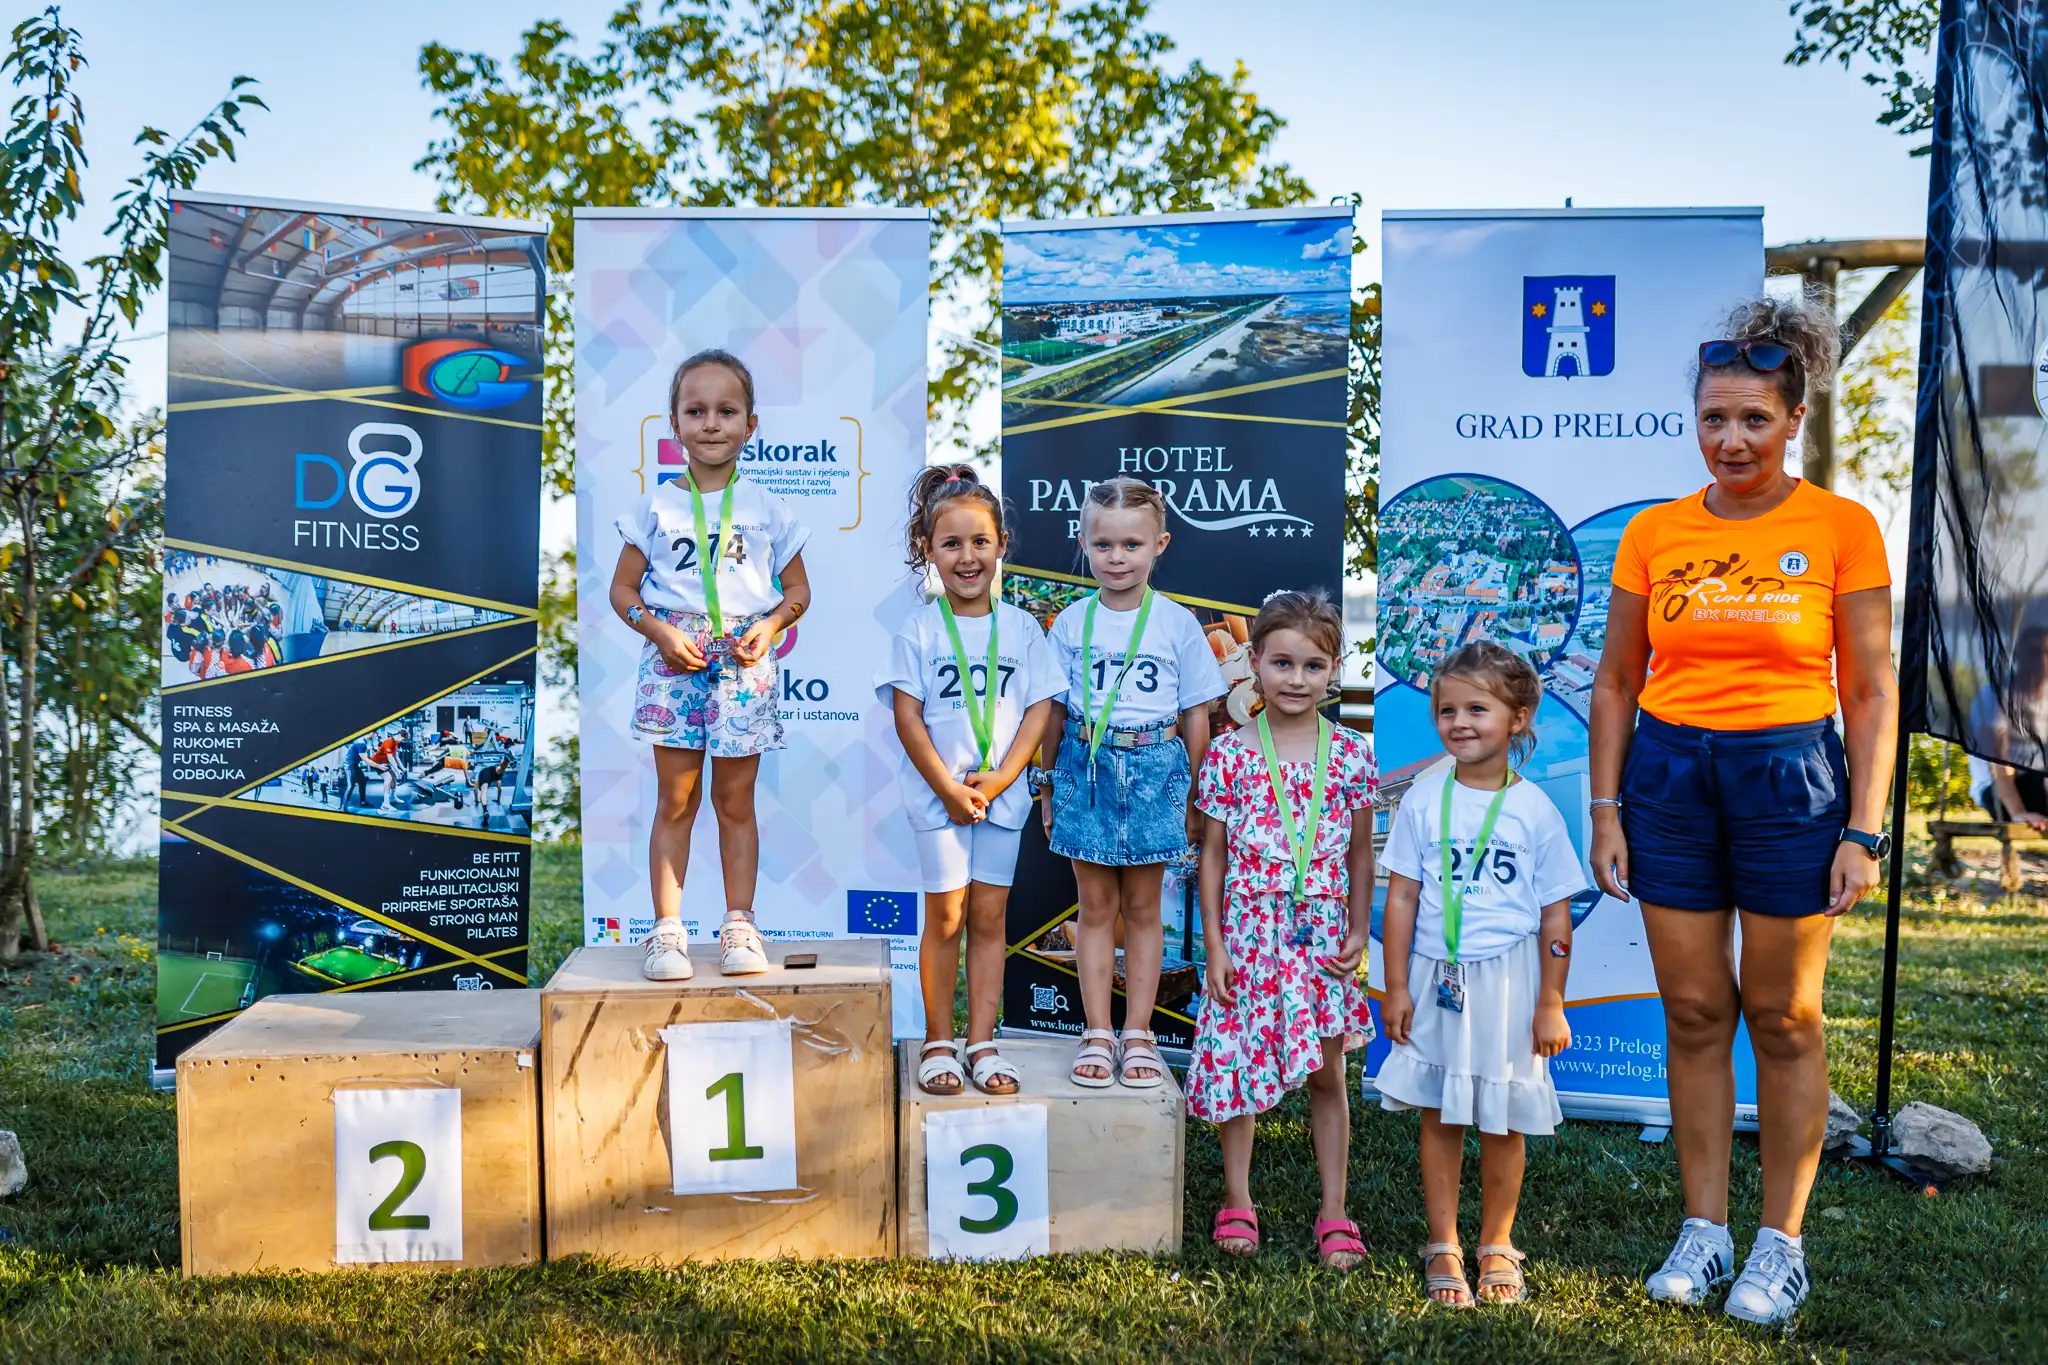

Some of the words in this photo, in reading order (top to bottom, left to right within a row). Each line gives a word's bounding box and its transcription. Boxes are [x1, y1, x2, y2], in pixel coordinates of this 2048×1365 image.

[1455, 413, 1543, 439] GRAD
[1552, 412, 1684, 438] PRELOG
[737, 438, 837, 462] skorak
[1118, 446, 1233, 473] HOTEL
[784, 468, 812, 477] sustav
[807, 477, 831, 487] razvoj
[811, 487, 837, 495] centra
[1029, 478, 1290, 517] PARAMA
[294, 520, 420, 551] FITNESS
[671, 533, 747, 572] 274
[1761, 593, 1802, 604] RIDE
[1693, 608, 1720, 621] BK
[1724, 609, 1801, 624] PRELOG
[937, 664, 1016, 699] 207
[1092, 659, 1159, 693] 173
[173, 706, 233, 718] FITNESS
[803, 709, 859, 721] ustanova
[173, 721, 202, 733] SPA
[204, 721, 216, 733] &
[219, 718, 280, 733] MASAŽA
[173, 737, 244, 749] RUKOMET
[172, 753, 229, 765] FUTSAL
[172, 768, 246, 780] ODBOJKA
[473, 853, 490, 864] BE
[493, 851, 520, 863] FITT
[1438, 847, 1517, 885] 275
[420, 867, 520, 881] FUNKCIONALNI
[402, 882, 519, 897] REHABILITACIJSKI
[1464, 885, 1492, 895] ARIA
[381, 900, 447, 913] PRIPREME
[449, 894, 519, 911] SPORTAŠA
[429, 913, 485, 927] STRONG
[488, 912, 518, 924] MAN
[467, 926, 518, 939] PILATES
[787, 930, 834, 938] STRUKTURNI
[1569, 1034, 1602, 1052] 323
[1608, 1036, 1662, 1060] Prelog
[1554, 1060, 1668, 1082] www.prelog.h
[705, 1073, 764, 1162] 1
[368, 1141, 431, 1231] 2
[959, 1143, 1019, 1234] 3
